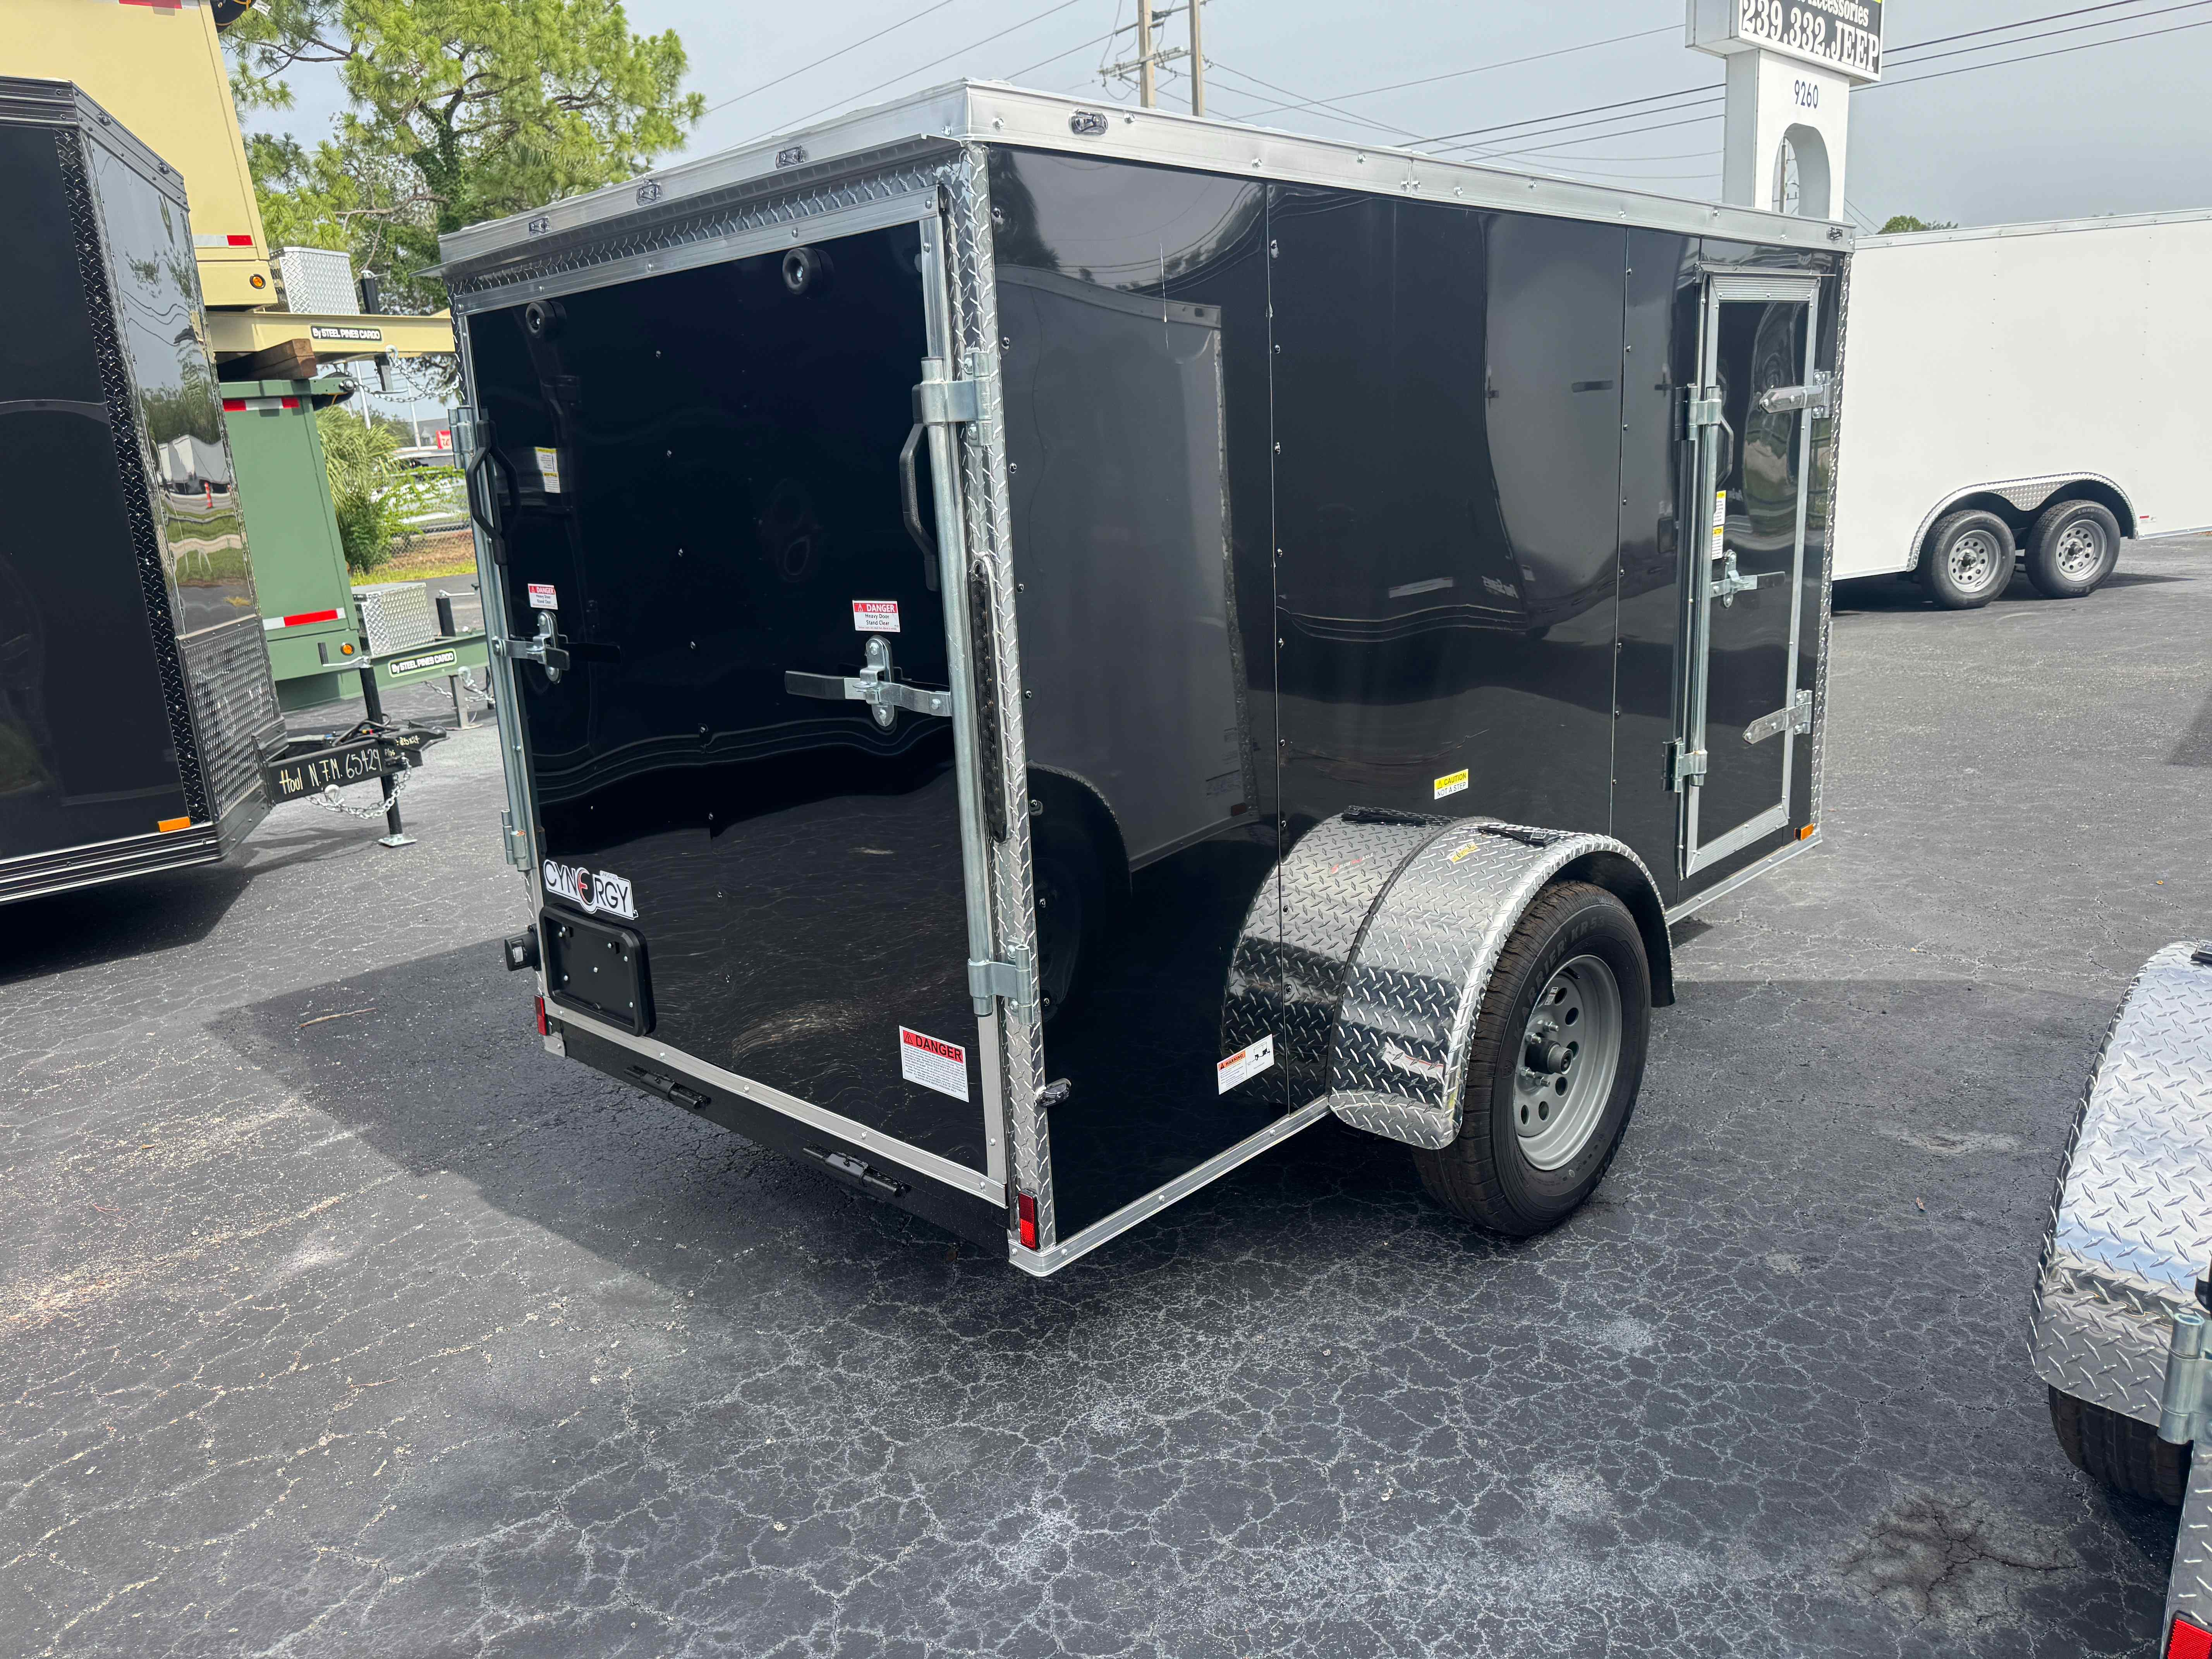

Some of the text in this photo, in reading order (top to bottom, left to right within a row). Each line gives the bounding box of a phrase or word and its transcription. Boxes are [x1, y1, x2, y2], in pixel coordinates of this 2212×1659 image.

[1808, 0, 1869, 27] cessories
[1742, 0, 1879, 72] 239.332.JEEP
[1795, 80, 1818, 109] 9260
[321, 328, 341, 338] STEEL
[340, 329, 359, 338] PINES
[359, 330, 380, 339] CARGO
[866, 604, 895, 613] DANGER
[400, 660, 417, 671] STEEL
[346, 749, 382, 778] 65429
[1437, 788, 1448, 796] NOT
[1454, 782, 1466, 792] STEP
[1444, 773, 1466, 785] CAUTION
[1571, 915, 1605, 942] KR53
[915, 1035, 962, 1062] DANGER
